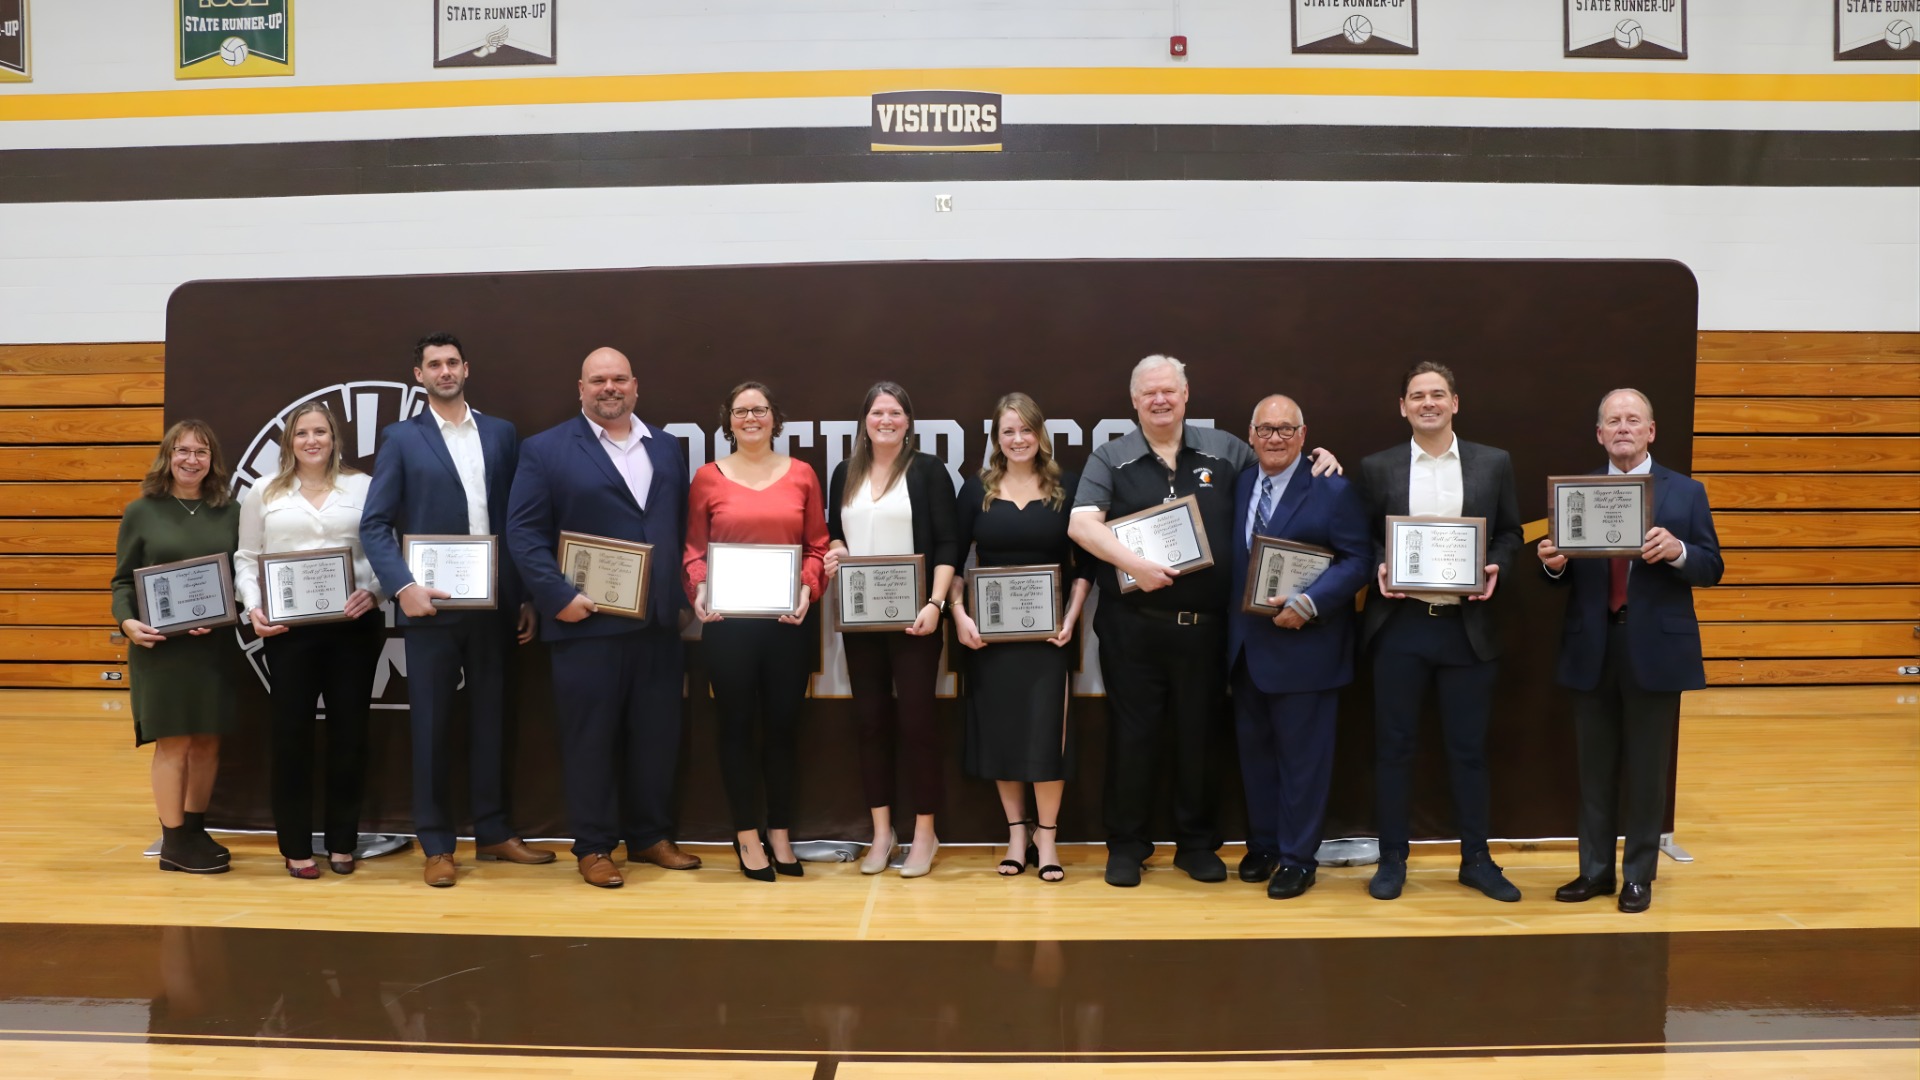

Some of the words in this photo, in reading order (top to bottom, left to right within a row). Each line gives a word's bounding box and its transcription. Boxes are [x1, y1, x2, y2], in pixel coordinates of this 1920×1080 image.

[447, 5, 481, 21] STATE
[484, 3, 546, 20] RUNNER-UP
[1576, 0, 1611, 11] STATE
[1614, 0, 1676, 12] RUNNER-UP
[1846, 0, 1882, 13] STATE
[0, 20, 19, 37] -UP
[185, 16, 219, 32] STATE
[221, 12, 283, 31] RUNNER-UP
[877, 104, 997, 132] VISITORS
